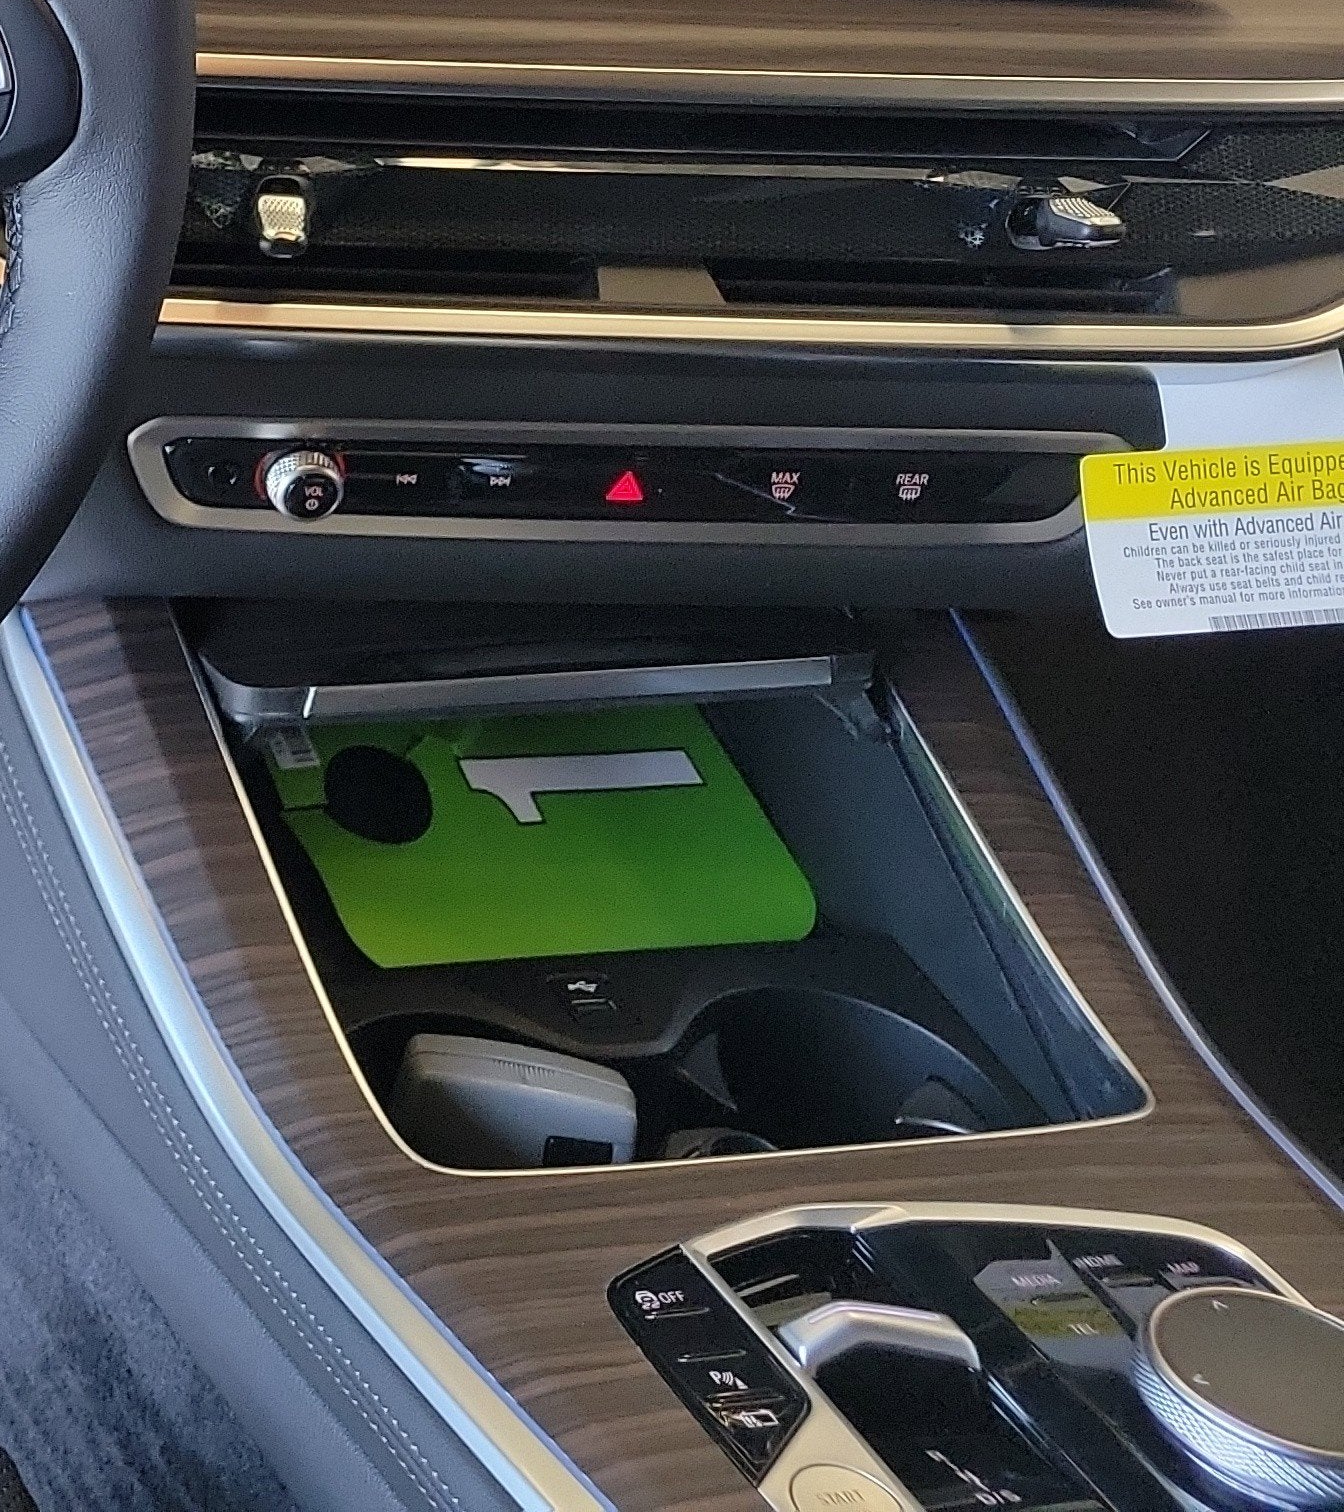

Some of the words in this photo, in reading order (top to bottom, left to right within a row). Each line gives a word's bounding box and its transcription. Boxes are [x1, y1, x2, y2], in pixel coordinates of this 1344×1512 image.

[771, 471, 801, 484] MAX
[895, 473, 929, 486] REAR
[1113, 462, 1156, 484] This
[1163, 457, 1237, 481] Vehicle
[1244, 455, 1261, 477] is
[304, 485, 324, 497] VOL
[1170, 482, 1268, 510] Advanced
[1277, 480, 1305, 503] Air
[1312, 479, 1344, 504] Bag
[1149, 522, 1190, 541] Even
[1193, 519, 1229, 538] with
[1234, 512, 1314, 537] Advanced
[1321, 510, 1343, 530] Air
[1124, 545, 1168, 558] Children
[1171, 545, 1189, 556] can
[1193, 542, 1205, 553] be
[1208, 539, 1236, 552] killed
[1240, 541, 1251, 550] or
[1254, 536, 1301, 550] seriously
[1155, 557, 1174, 569] The
[1178, 556, 1202, 568] back
[1206, 555, 1227, 566] seat
[1230, 552, 1240, 564] is
[1243, 551, 1259, 563] the
[1263, 549, 1293, 562] safest
[1297, 547, 1324, 562] place
[1327, 546, 1342, 558] for
[1157, 570, 1187, 582] Never
[1191, 570, 1208, 582] put
[1211, 568, 1217, 579] a
[1220, 563, 1276, 577] rear-facing
[1280, 561, 1305, 574] child
[1309, 560, 1330, 572] seat
[1333, 559, 1343, 569] in
[1170, 582, 1206, 595] Always
[1209, 581, 1227, 592] use
[1231, 579, 1251, 591] seat
[1255, 576, 1281, 588] belts
[1284, 574, 1303, 586] and
[1306, 572, 1332, 585] child
[1132, 598, 1152, 610] See
[1156, 595, 1196, 608] owner's
[1200, 592, 1237, 605] manual
[1240, 591, 1255, 603] for
[1259, 590, 1285, 601] more
[1288, 586, 1344, 600] informatio
[1167, 1261, 1201, 1275] MAP
[658, 1290, 685, 1304] OFF
